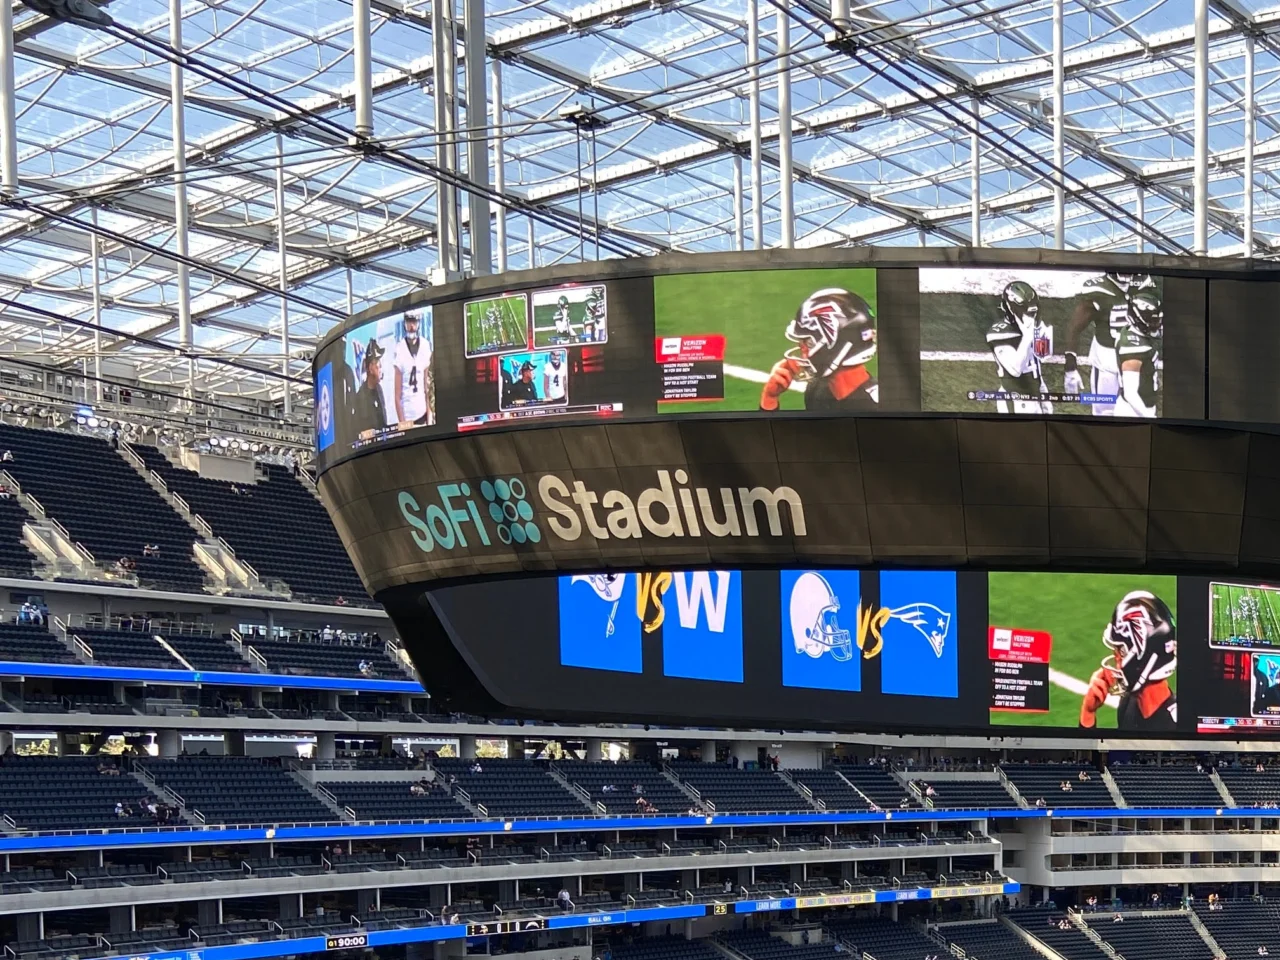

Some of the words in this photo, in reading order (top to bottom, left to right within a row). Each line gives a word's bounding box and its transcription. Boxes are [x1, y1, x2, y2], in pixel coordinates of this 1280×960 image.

[398, 482, 491, 552] SoFi
[538, 468, 807, 542] Stadium
[716, 905, 726, 913] 25
[756, 901, 768, 910] LEARN
[769, 901, 782, 910] MORE
[338, 936, 365, 947] 90:00
